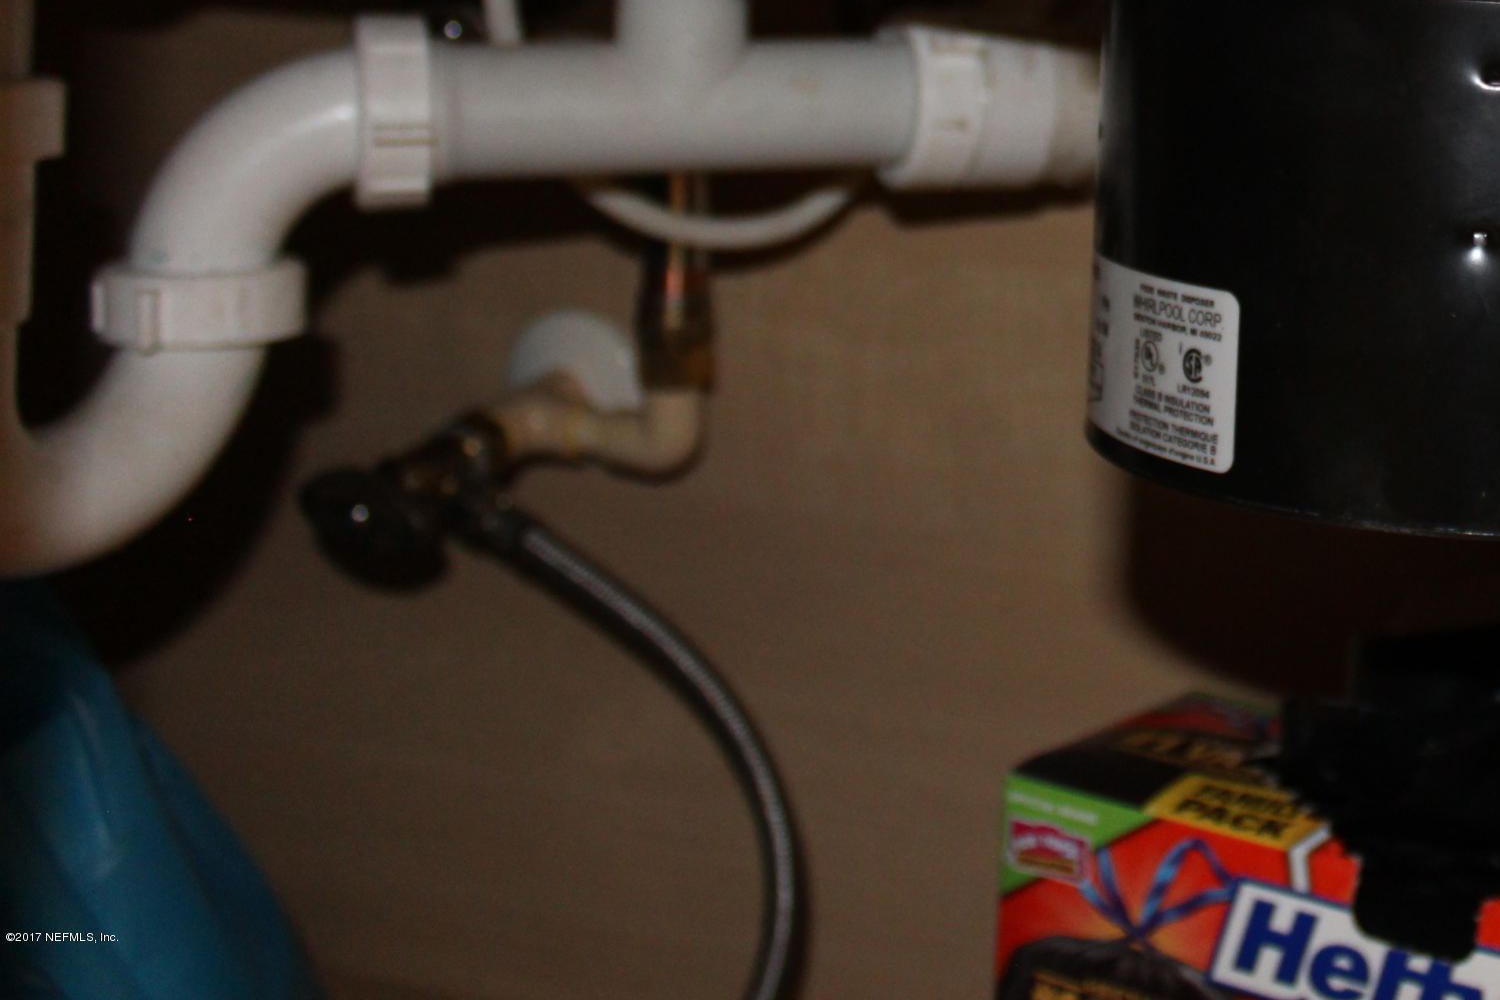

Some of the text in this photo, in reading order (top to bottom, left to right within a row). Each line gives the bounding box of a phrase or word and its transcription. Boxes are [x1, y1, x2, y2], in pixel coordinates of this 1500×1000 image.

[1133, 293, 1185, 322] WHIRLPOOL
[1164, 393, 1211, 415] INSULATION
[1164, 405, 1215, 428] PROTECTION
[1176, 799, 1288, 840] PACK
